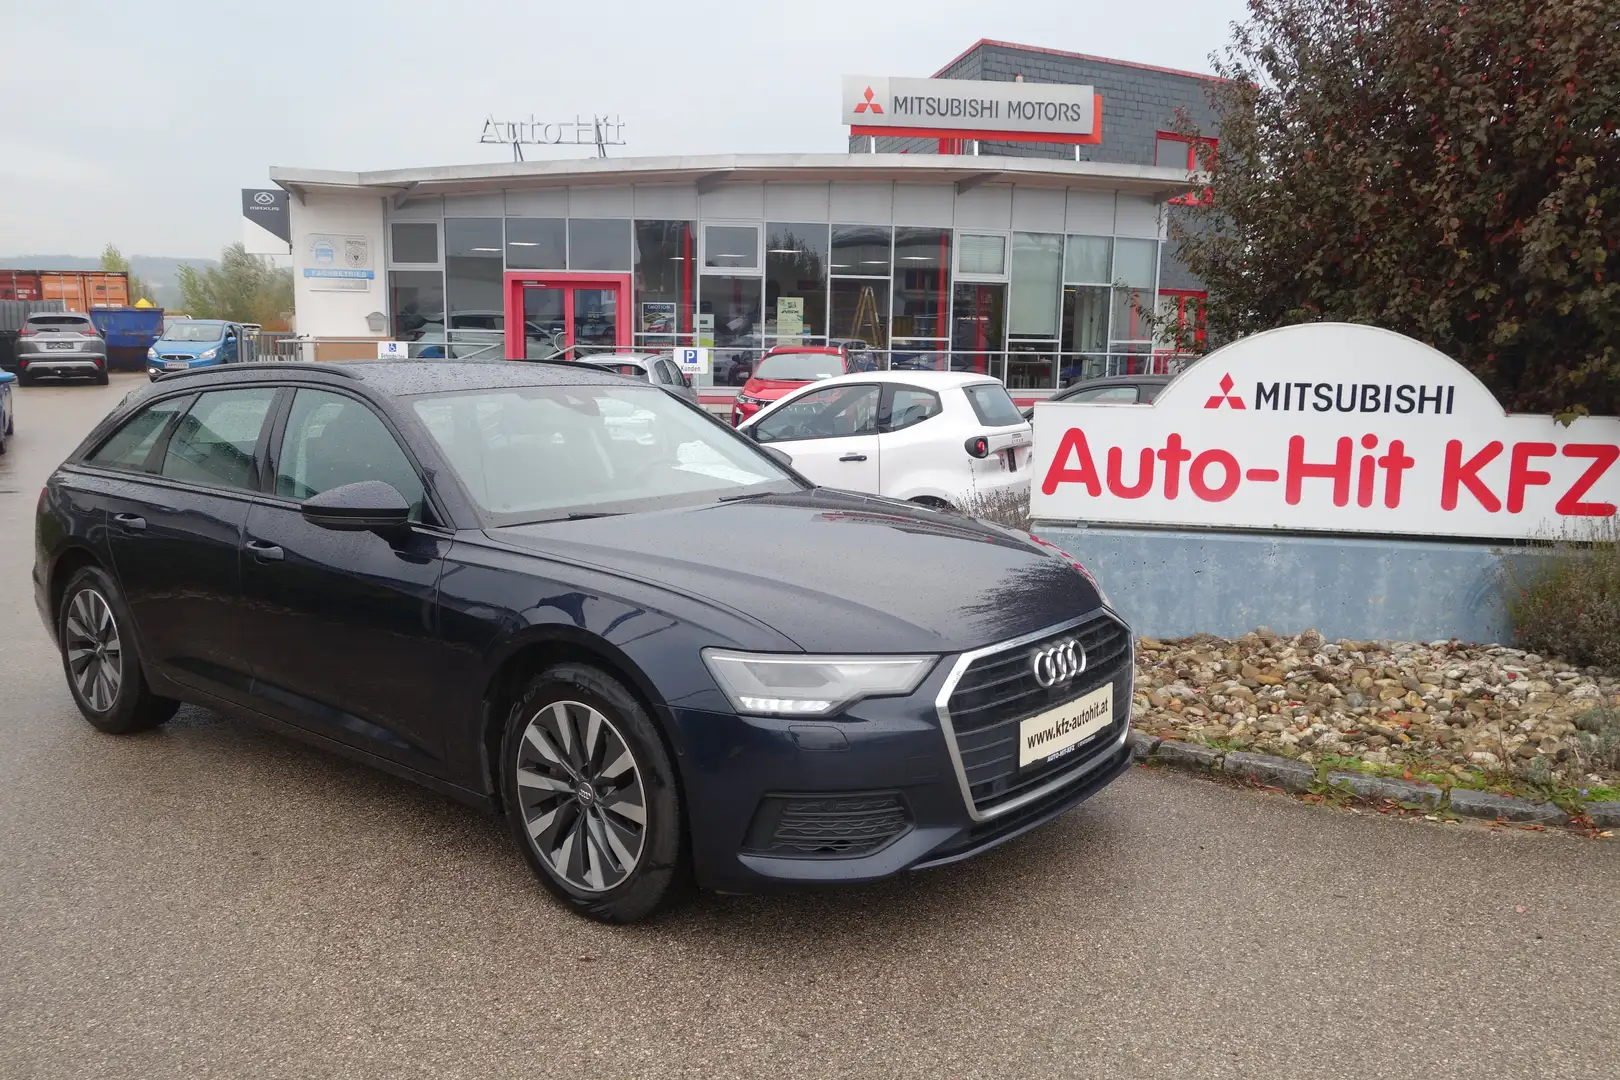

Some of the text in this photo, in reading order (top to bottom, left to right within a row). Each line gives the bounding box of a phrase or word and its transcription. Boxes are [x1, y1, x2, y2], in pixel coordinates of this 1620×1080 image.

[893, 96, 1081, 122] MITSUBISHI MOTORS
[480, 112, 626, 144] Auto Hit
[311, 270, 367, 278] FACHBETRIEB
[1255, 382, 1455, 415] MITSUBISHI
[1041, 427, 1620, 517] Auto-Hit KFZ
[1027, 697, 1108, 749] www.kfz-autohit.at
